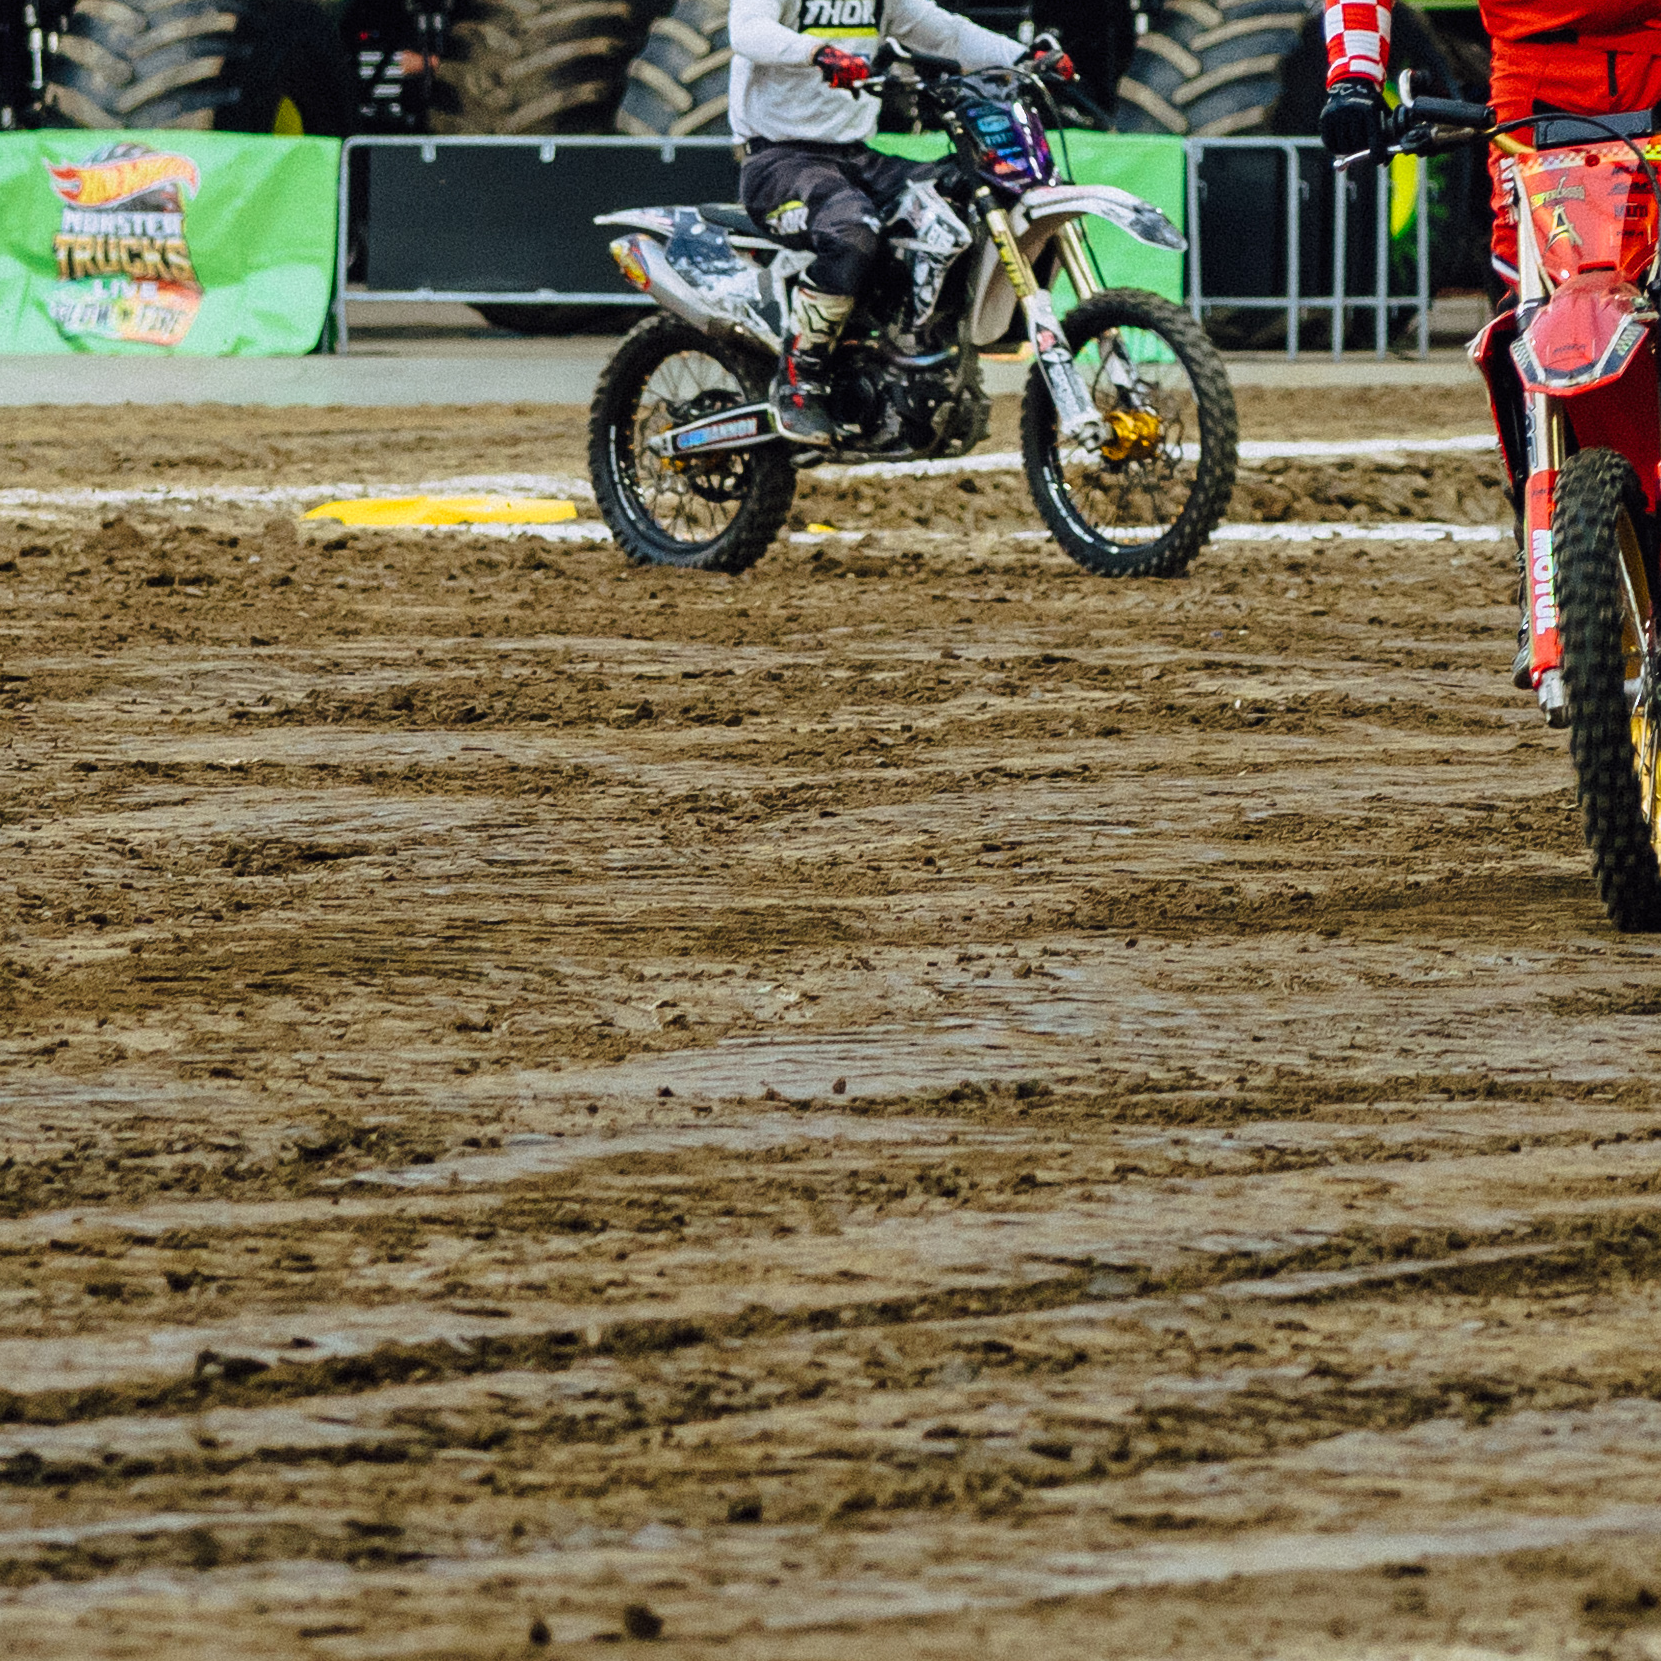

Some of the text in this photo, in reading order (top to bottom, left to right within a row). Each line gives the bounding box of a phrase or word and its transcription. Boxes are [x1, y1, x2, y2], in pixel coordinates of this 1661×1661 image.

[54, 234, 199, 282] TRUCKS
[93, 278, 159, 299] LIVE
[1532, 529, 1558, 635] MOTUL
